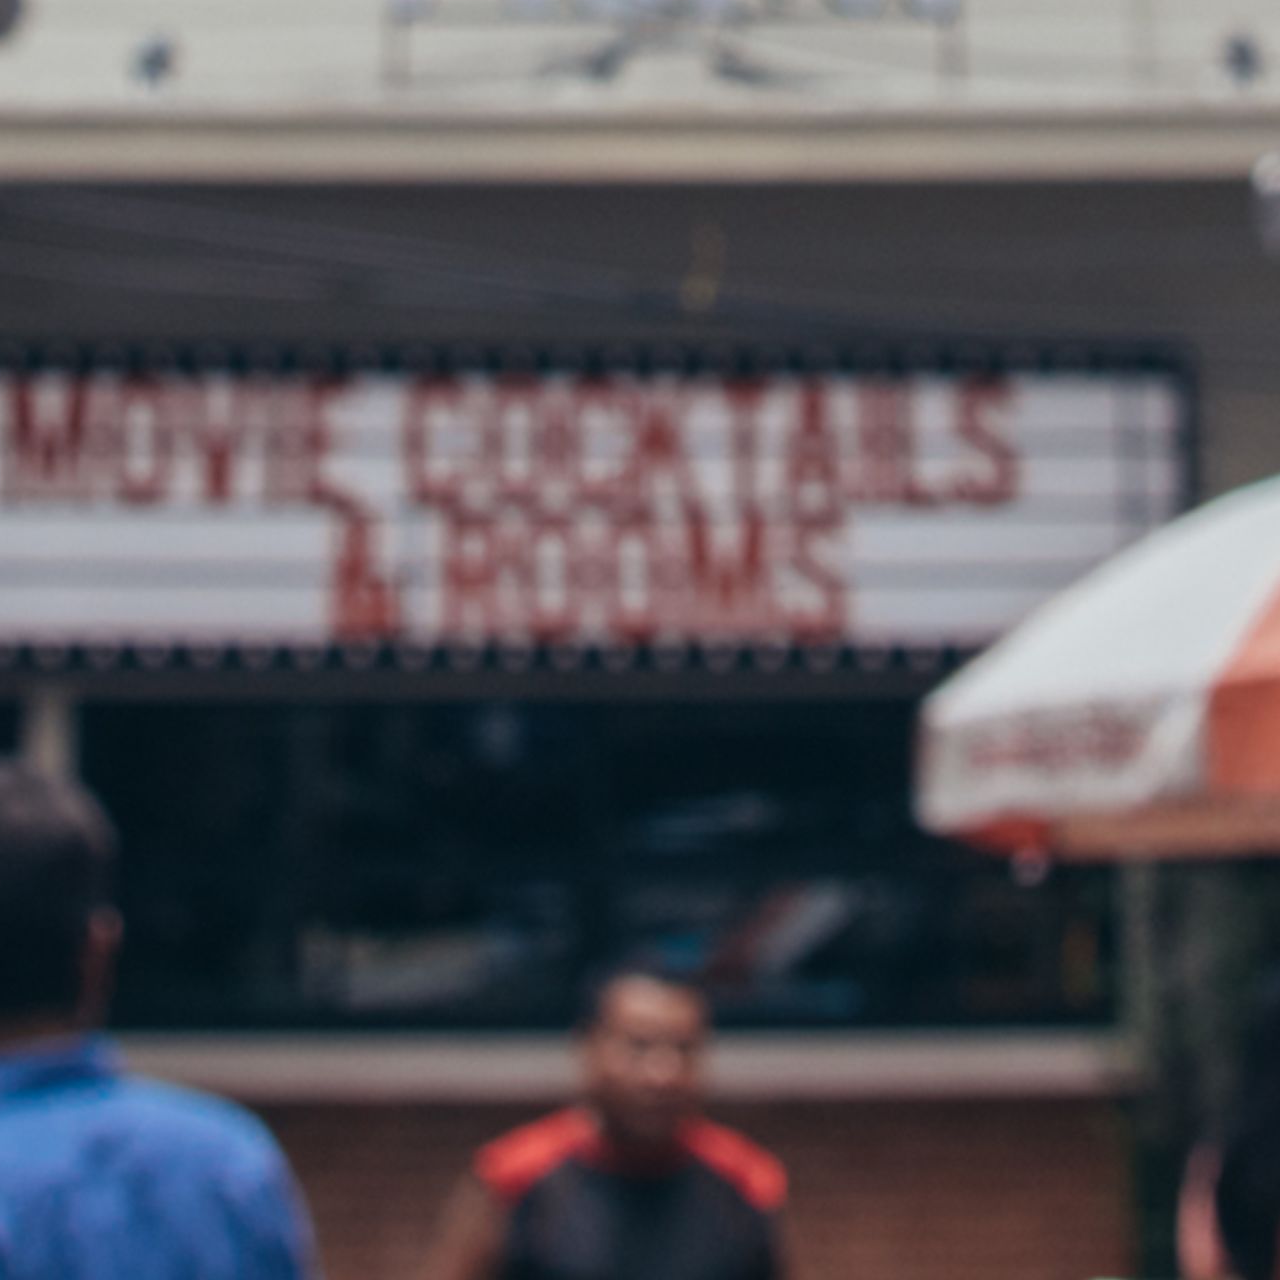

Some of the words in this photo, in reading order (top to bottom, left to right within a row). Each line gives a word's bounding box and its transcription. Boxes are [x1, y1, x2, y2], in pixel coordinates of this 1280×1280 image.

[0, 372, 352, 506] MOVIE
[402, 372, 1024, 506] COCKTAILS
[440, 500, 850, 643] ROOMS
